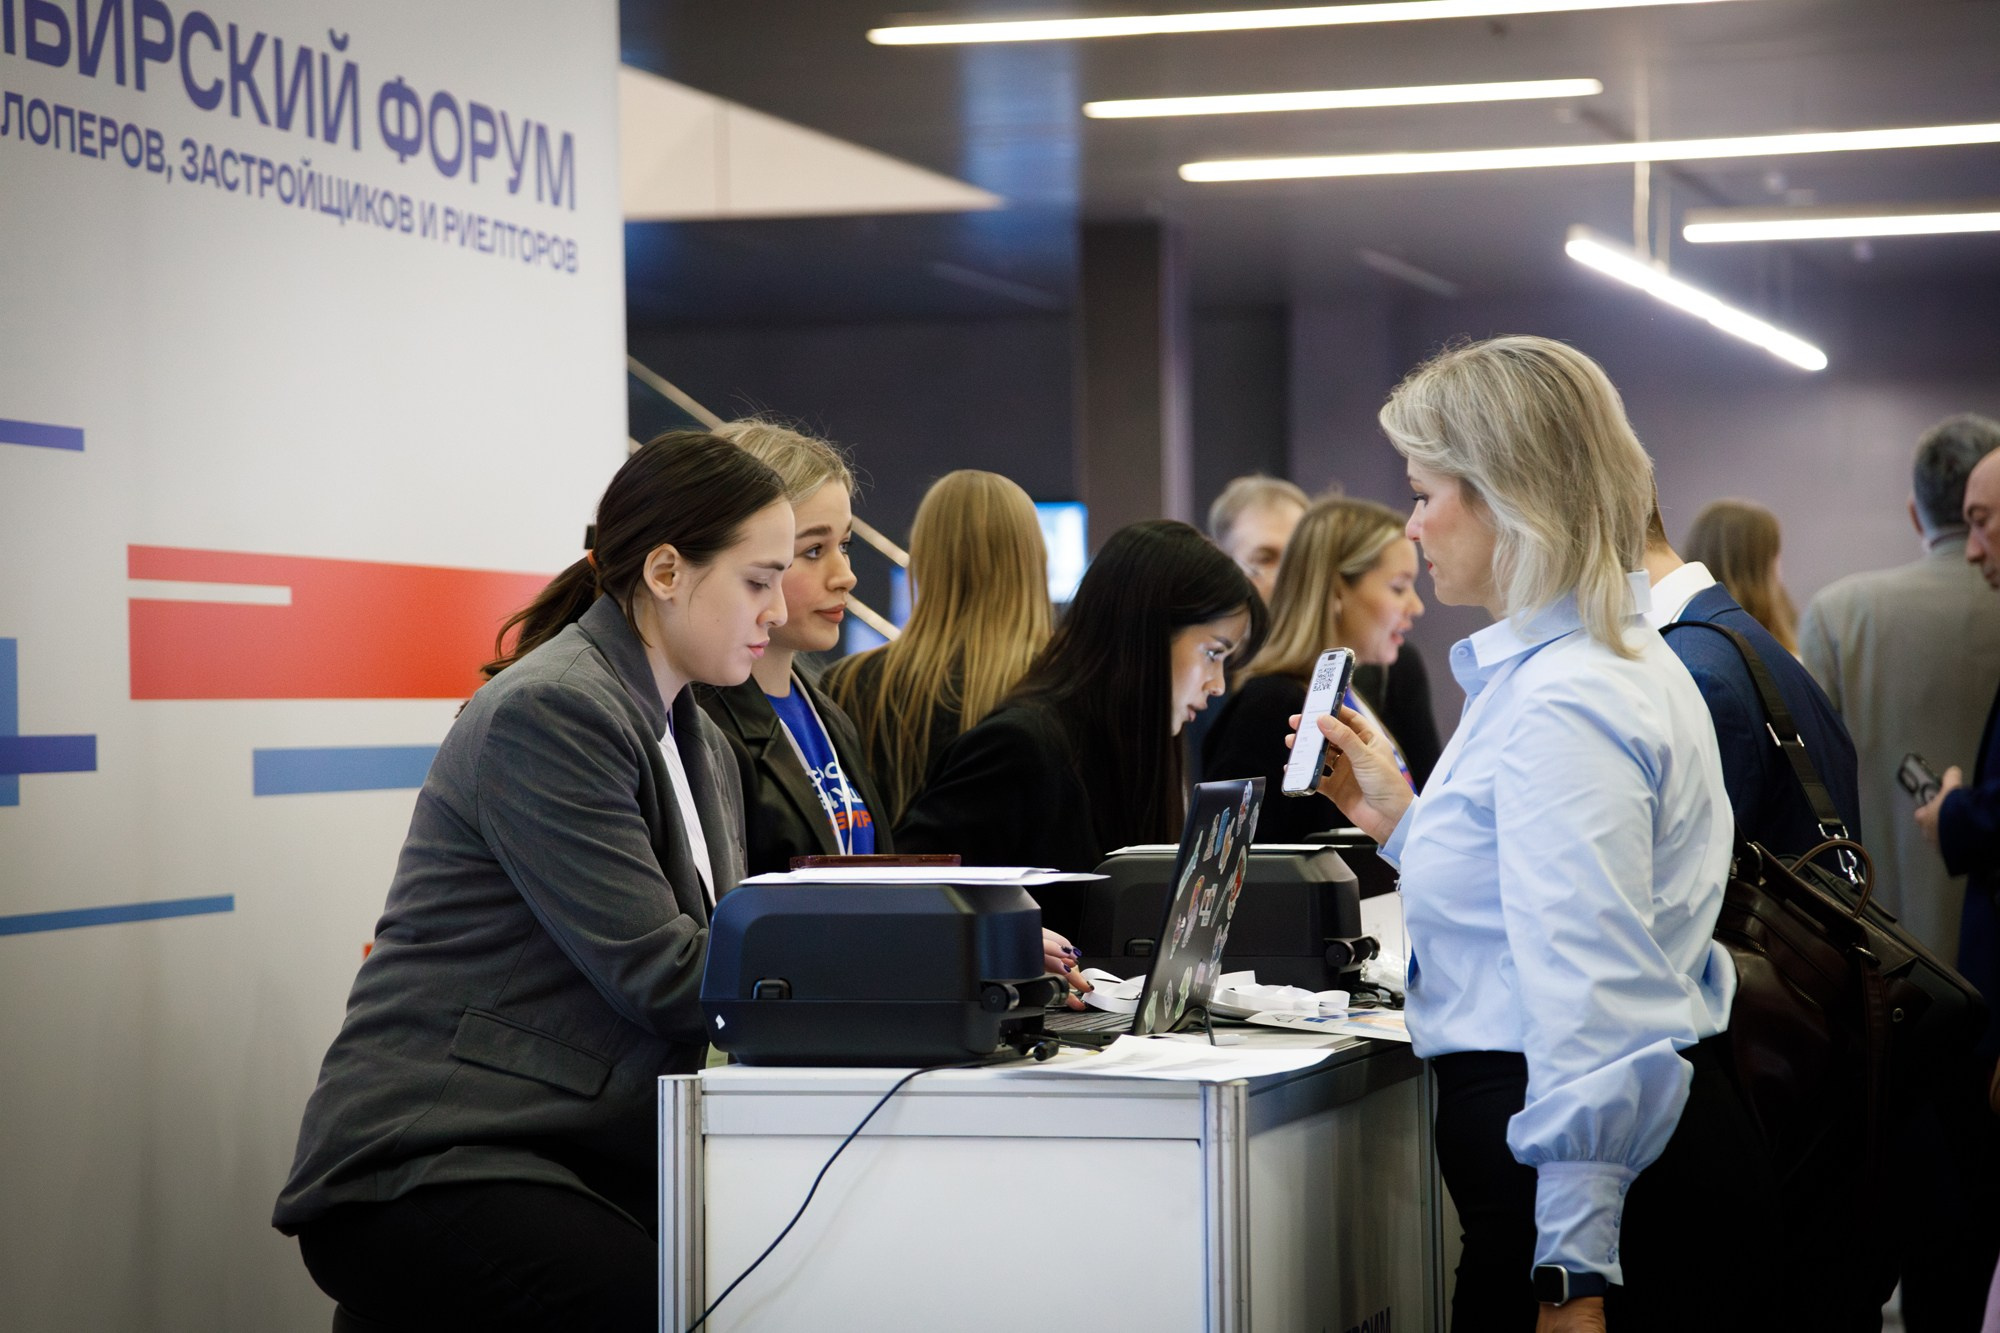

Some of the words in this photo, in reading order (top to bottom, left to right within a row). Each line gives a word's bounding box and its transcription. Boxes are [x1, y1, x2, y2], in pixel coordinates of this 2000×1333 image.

[180, 138, 416, 235] ЗАСТРОЙЩИКОВ
[419, 200, 438, 240] И
[443, 205, 579, 274] РИЕЛТОРОВ
[377, 75, 577, 211] ФОРУМ
